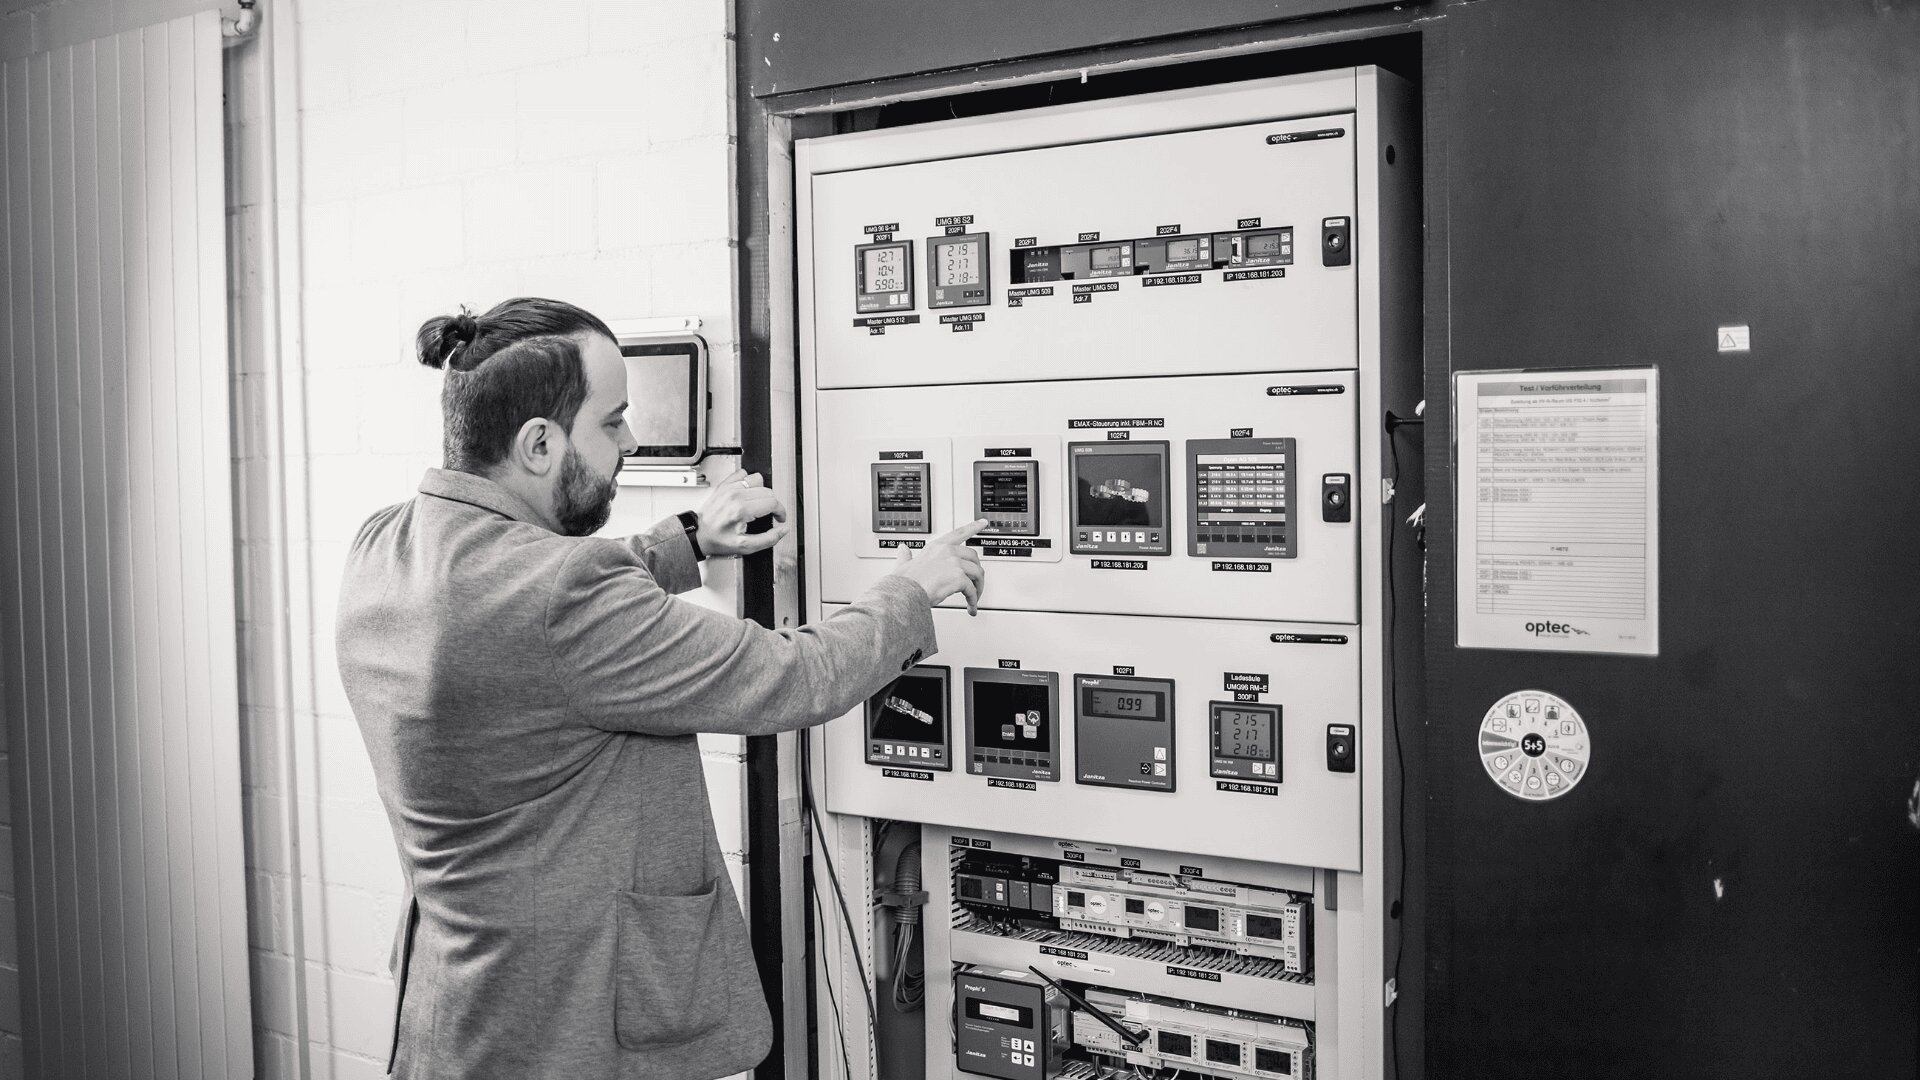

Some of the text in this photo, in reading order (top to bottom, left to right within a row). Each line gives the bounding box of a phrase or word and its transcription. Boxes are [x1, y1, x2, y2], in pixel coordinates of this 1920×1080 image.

[1272, 134, 1291, 143] optec
[1525, 621, 1570, 636] optec
[1118, 697, 1142, 711] 0.99
[1524, 740, 1543, 751] 5+5
